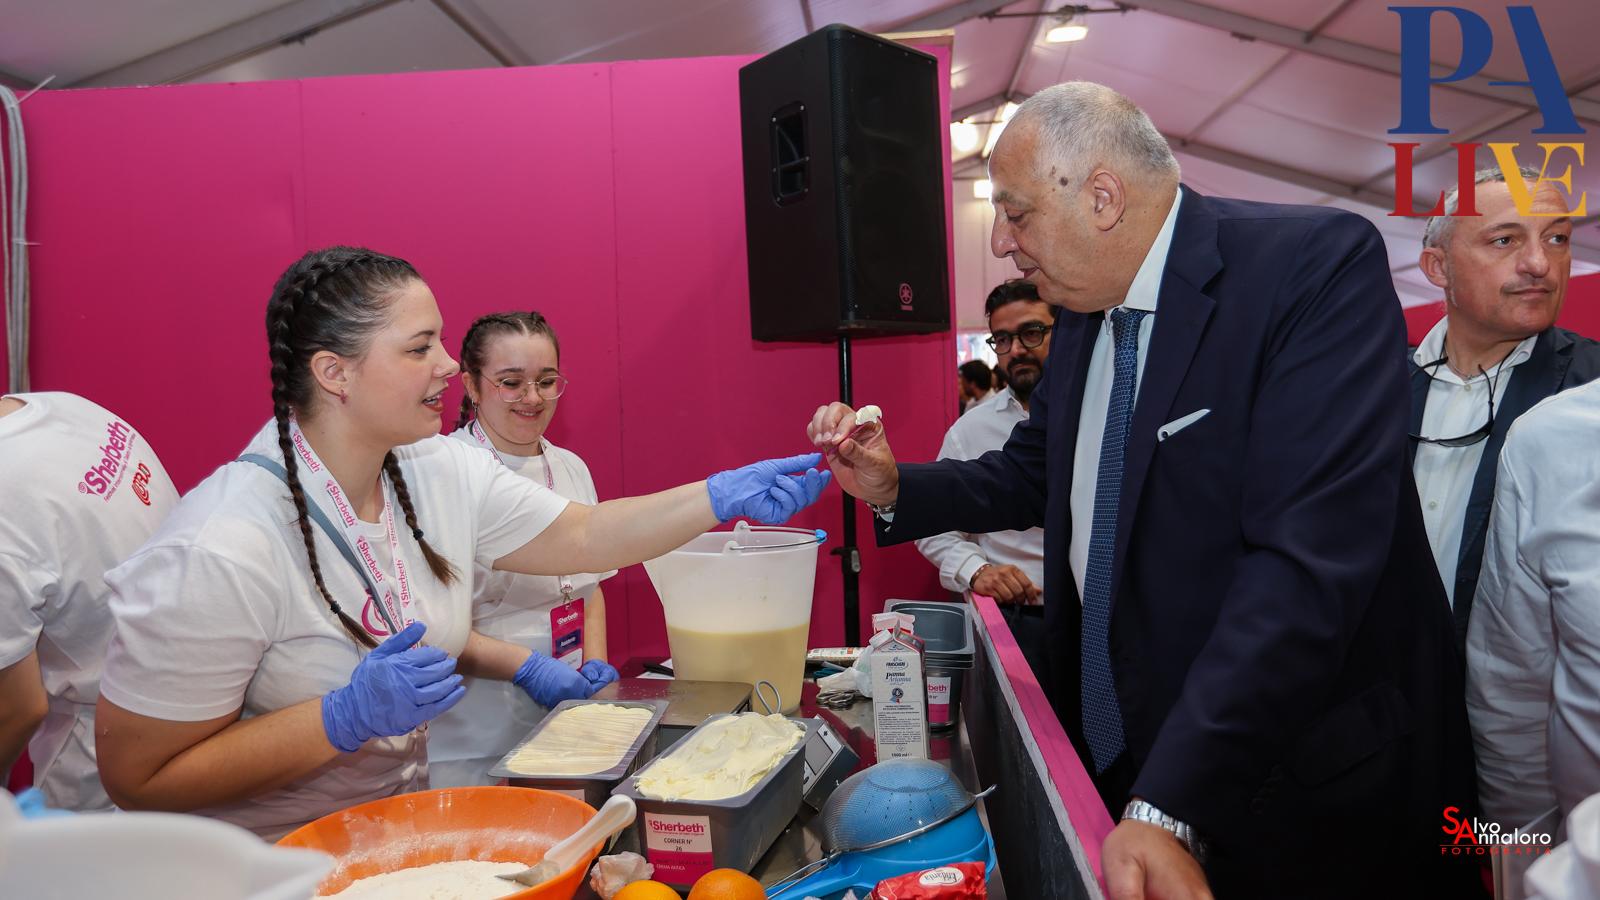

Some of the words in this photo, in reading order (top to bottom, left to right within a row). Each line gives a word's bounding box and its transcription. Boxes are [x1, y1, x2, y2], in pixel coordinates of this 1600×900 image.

[84, 420, 131, 495] Sherbeth
[295, 435, 321, 472] Sherbeth
[330, 486, 355, 527] Sherbeth
[360, 541, 383, 582] Sherbeth
[928, 684, 947, 692] beth
[653, 820, 704, 832] Sherbeth
